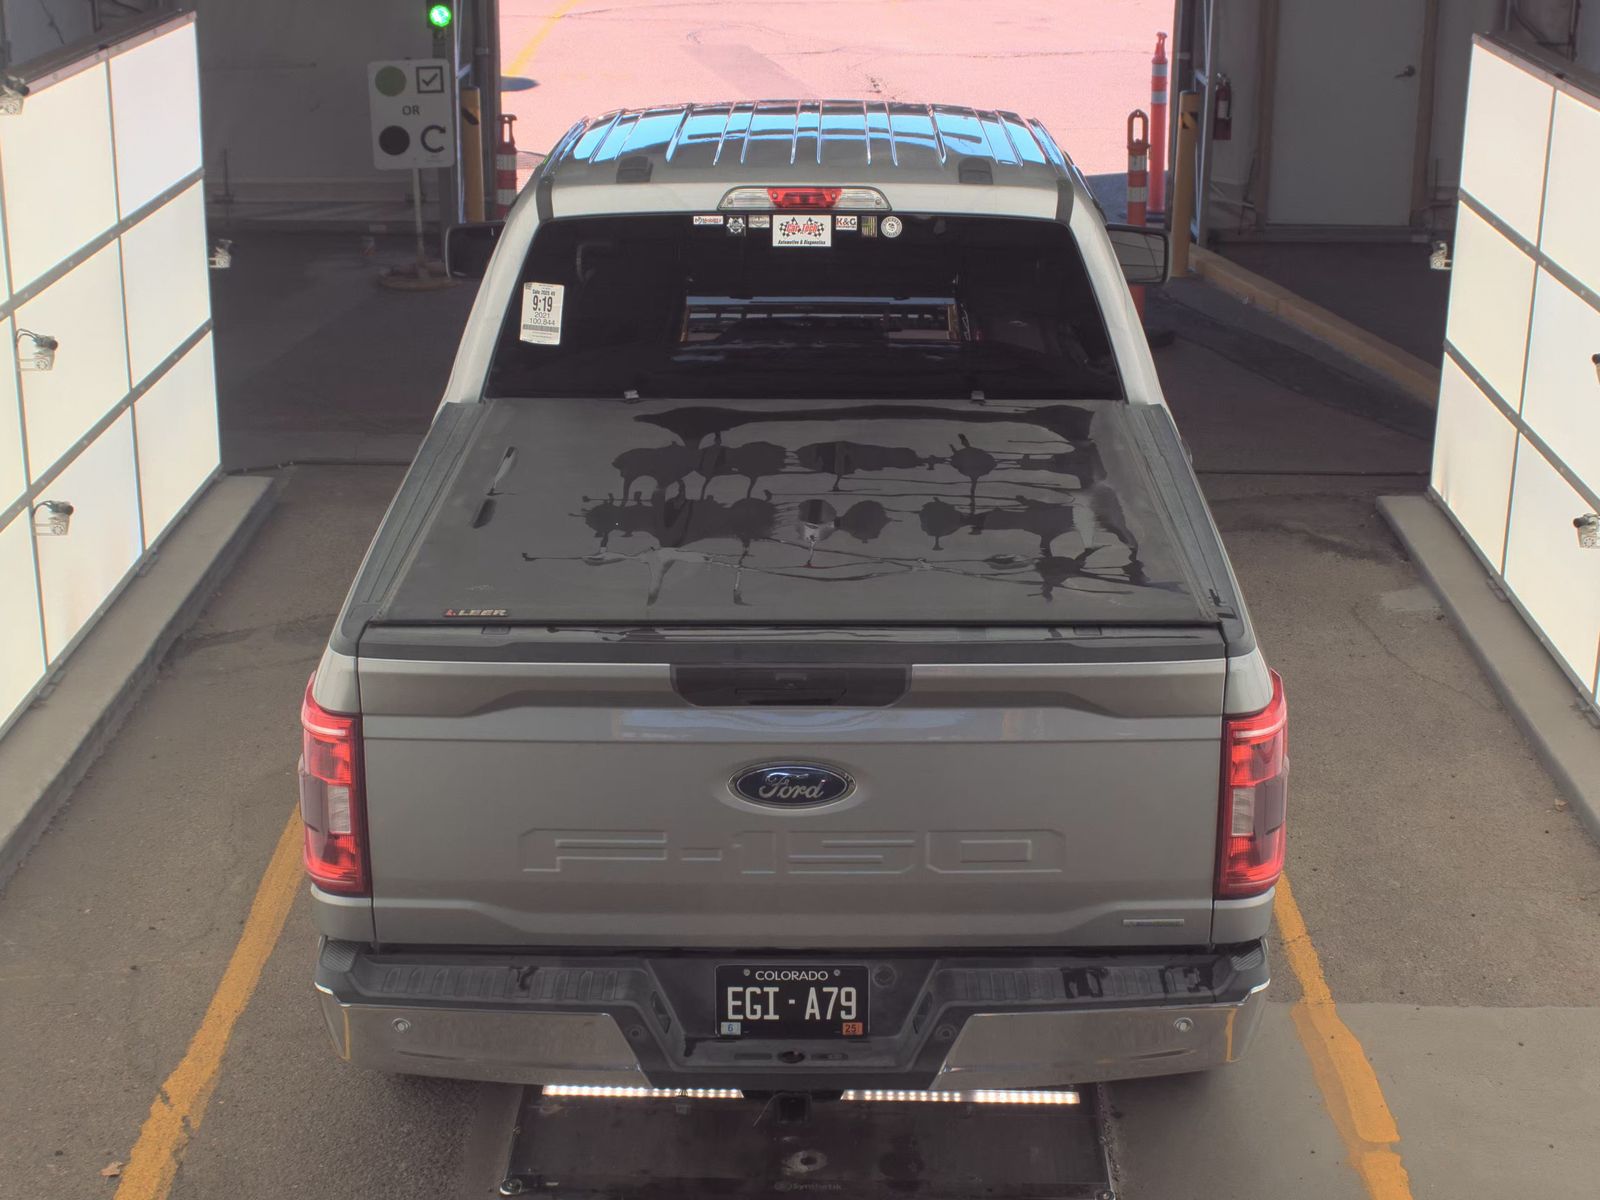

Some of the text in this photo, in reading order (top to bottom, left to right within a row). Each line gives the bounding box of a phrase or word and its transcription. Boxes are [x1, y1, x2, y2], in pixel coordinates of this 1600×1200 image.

[402, 105, 420, 116] OR
[836, 217, 857, 226] K&G
[758, 771, 825, 799] Ford
[755, 970, 829, 981] COLORADO
[845, 1024, 857, 1033] 25
